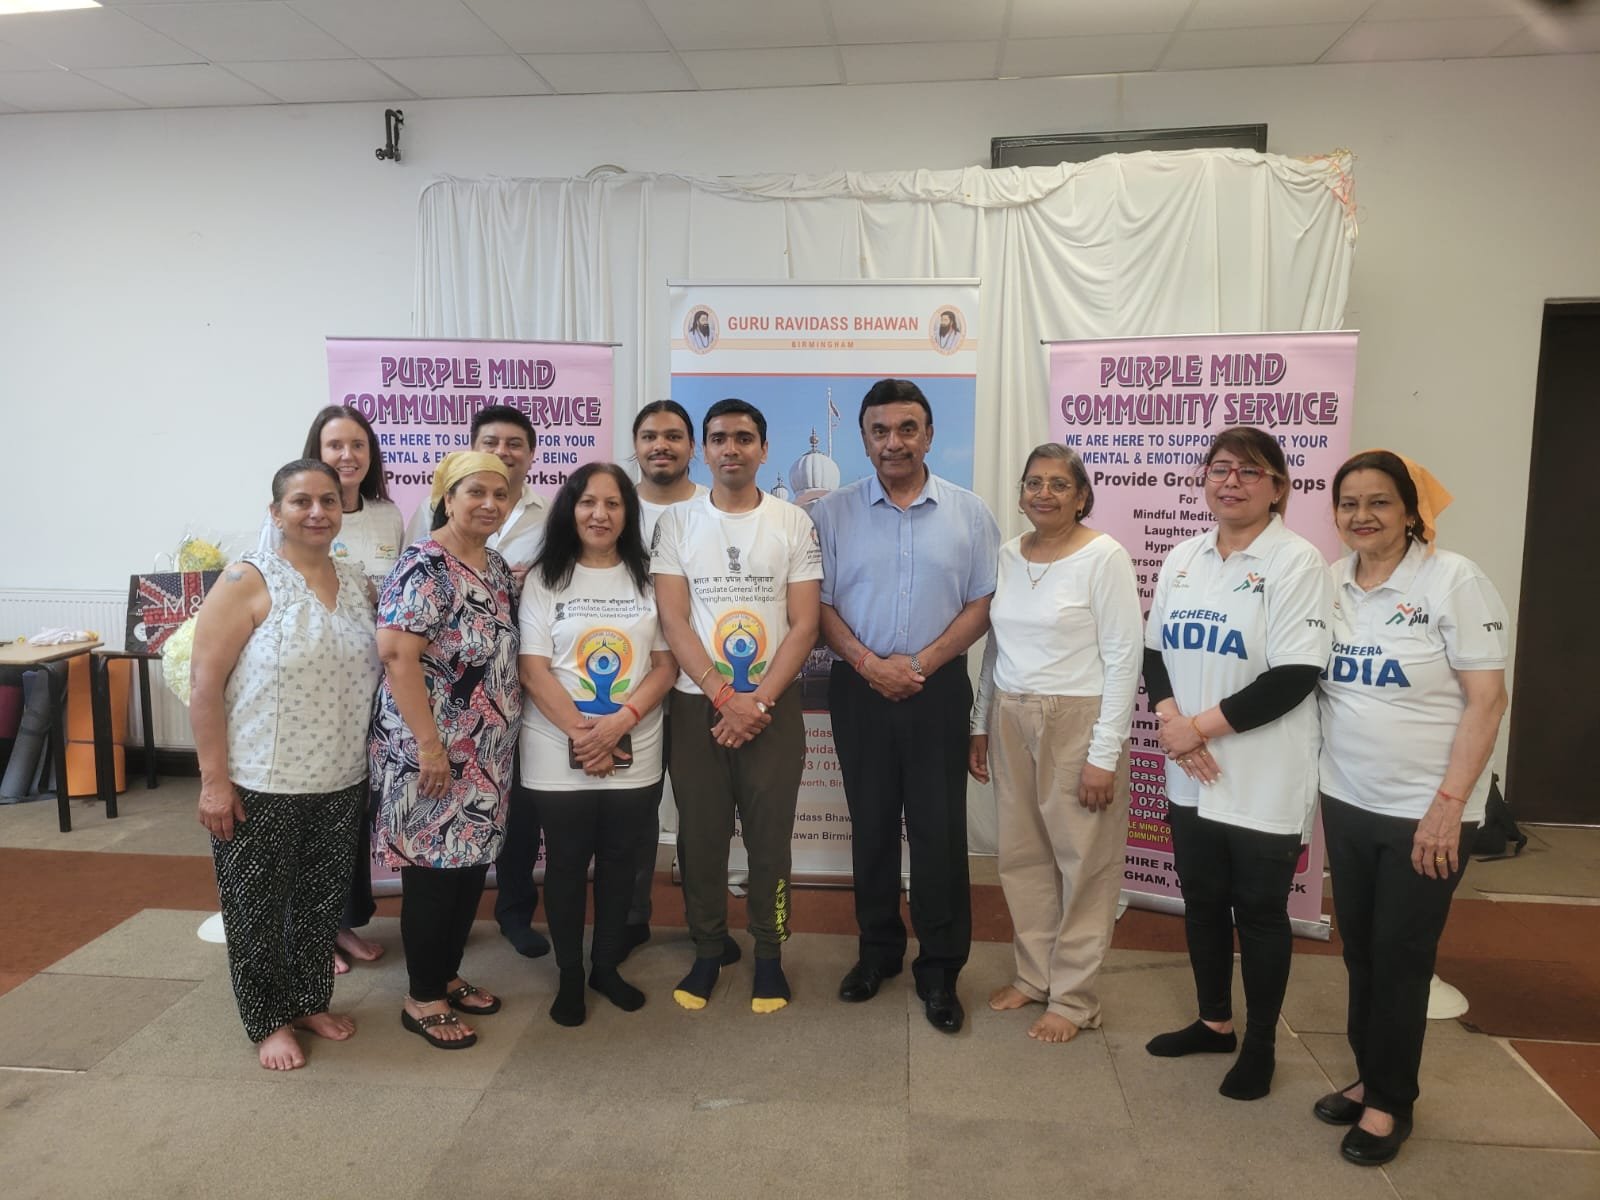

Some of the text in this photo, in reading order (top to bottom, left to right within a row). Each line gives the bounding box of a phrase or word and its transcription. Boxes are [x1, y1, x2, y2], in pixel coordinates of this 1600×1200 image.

[728, 316, 919, 331] GURU RAVIDASS BHAWAN
[791, 340, 854, 349] BIRMINGHAM
[381, 356, 555, 390] PURPLE MIND
[1100, 352, 1286, 390] PURPLE MIND
[1061, 391, 1338, 428] COMMUNITY SERVICE
[399, 433, 431, 446] HERE
[435, 433, 450, 446] TO
[538, 435, 595, 447] FOR YOUR
[1065, 434, 1082, 446] WE
[1086, 434, 1109, 446] ARE
[1113, 434, 1144, 446] HERE
[1148, 434, 1164, 446] TO
[1291, 435, 1328, 448] YOUR
[380, 451, 418, 463] ENTAL
[422, 451, 430, 463] &
[543, 452, 578, 464] BEING
[1083, 452, 1129, 464] MENTAL
[1134, 452, 1142, 464] &
[1094, 472, 1158, 487] Provide
[1179, 494, 1198, 504] For
[1133, 509, 1176, 520] Mindful
[1144, 525, 1197, 538] Laughter
[1151, 572, 1159, 583] &
[1169, 609, 1228, 623] #CHEER4
[1332, 641, 1383, 656] CHEER4
[1320, 655, 1412, 688] DIA
